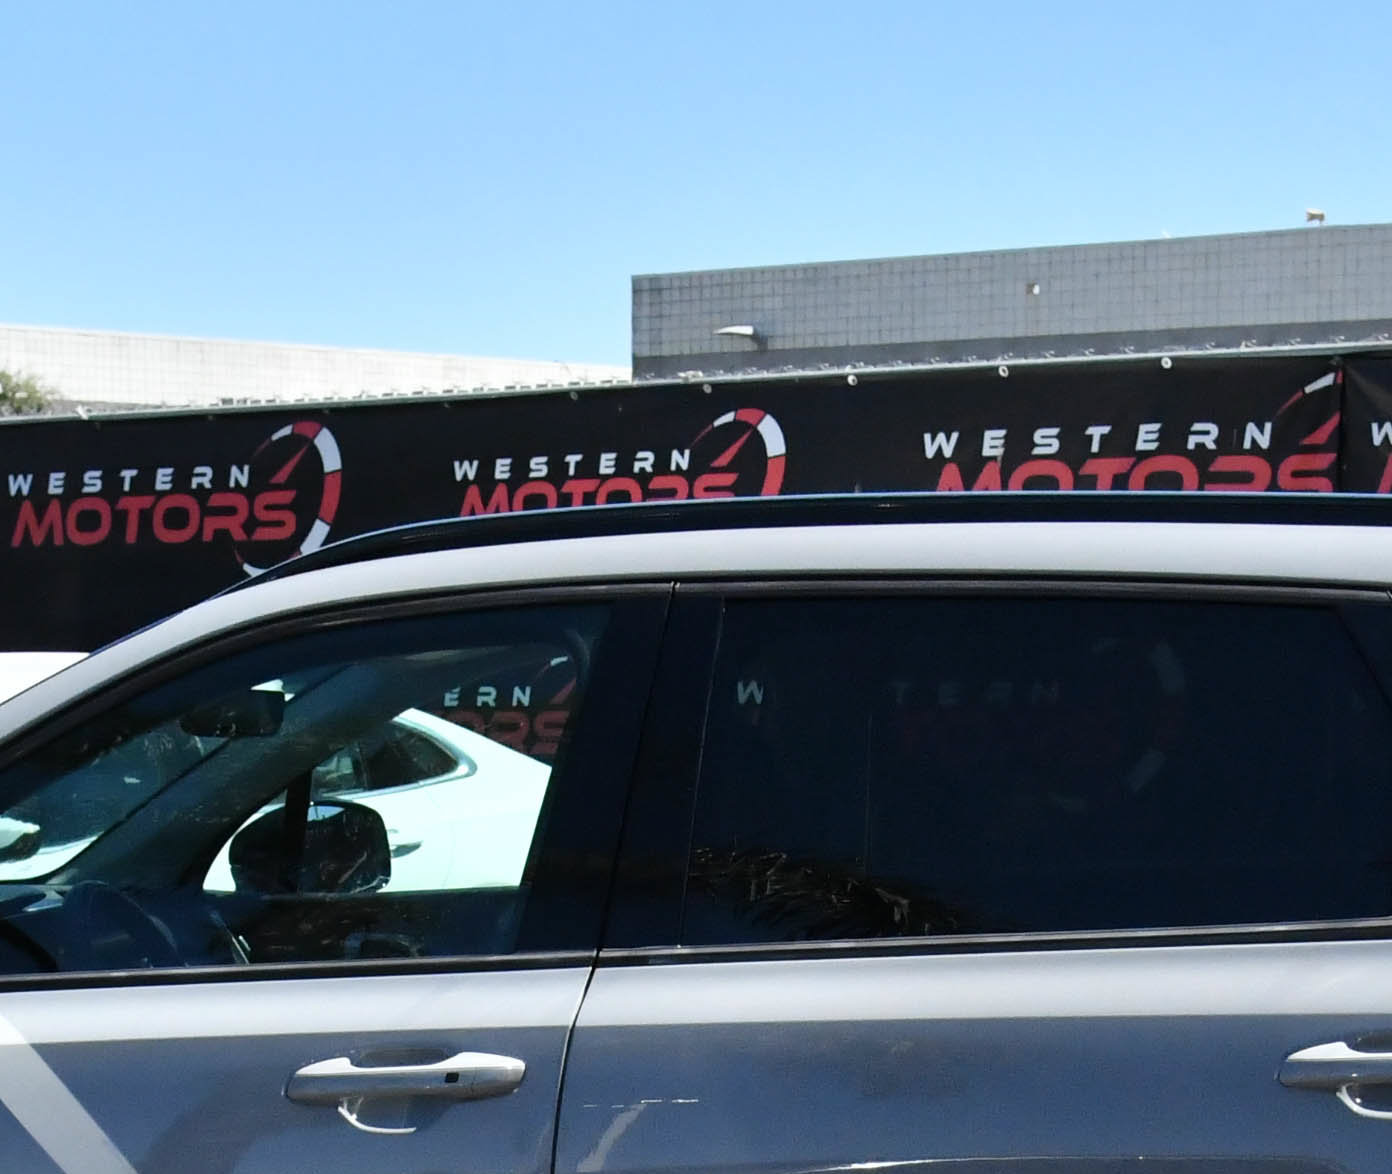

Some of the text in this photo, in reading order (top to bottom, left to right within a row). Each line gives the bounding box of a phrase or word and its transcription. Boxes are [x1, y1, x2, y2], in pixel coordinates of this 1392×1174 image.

[923, 421, 1273, 459] WESTERN
[8, 464, 250, 497] WESTERN
[453, 449, 691, 481] WESTERN
[11, 490, 298, 548] MOTORS
